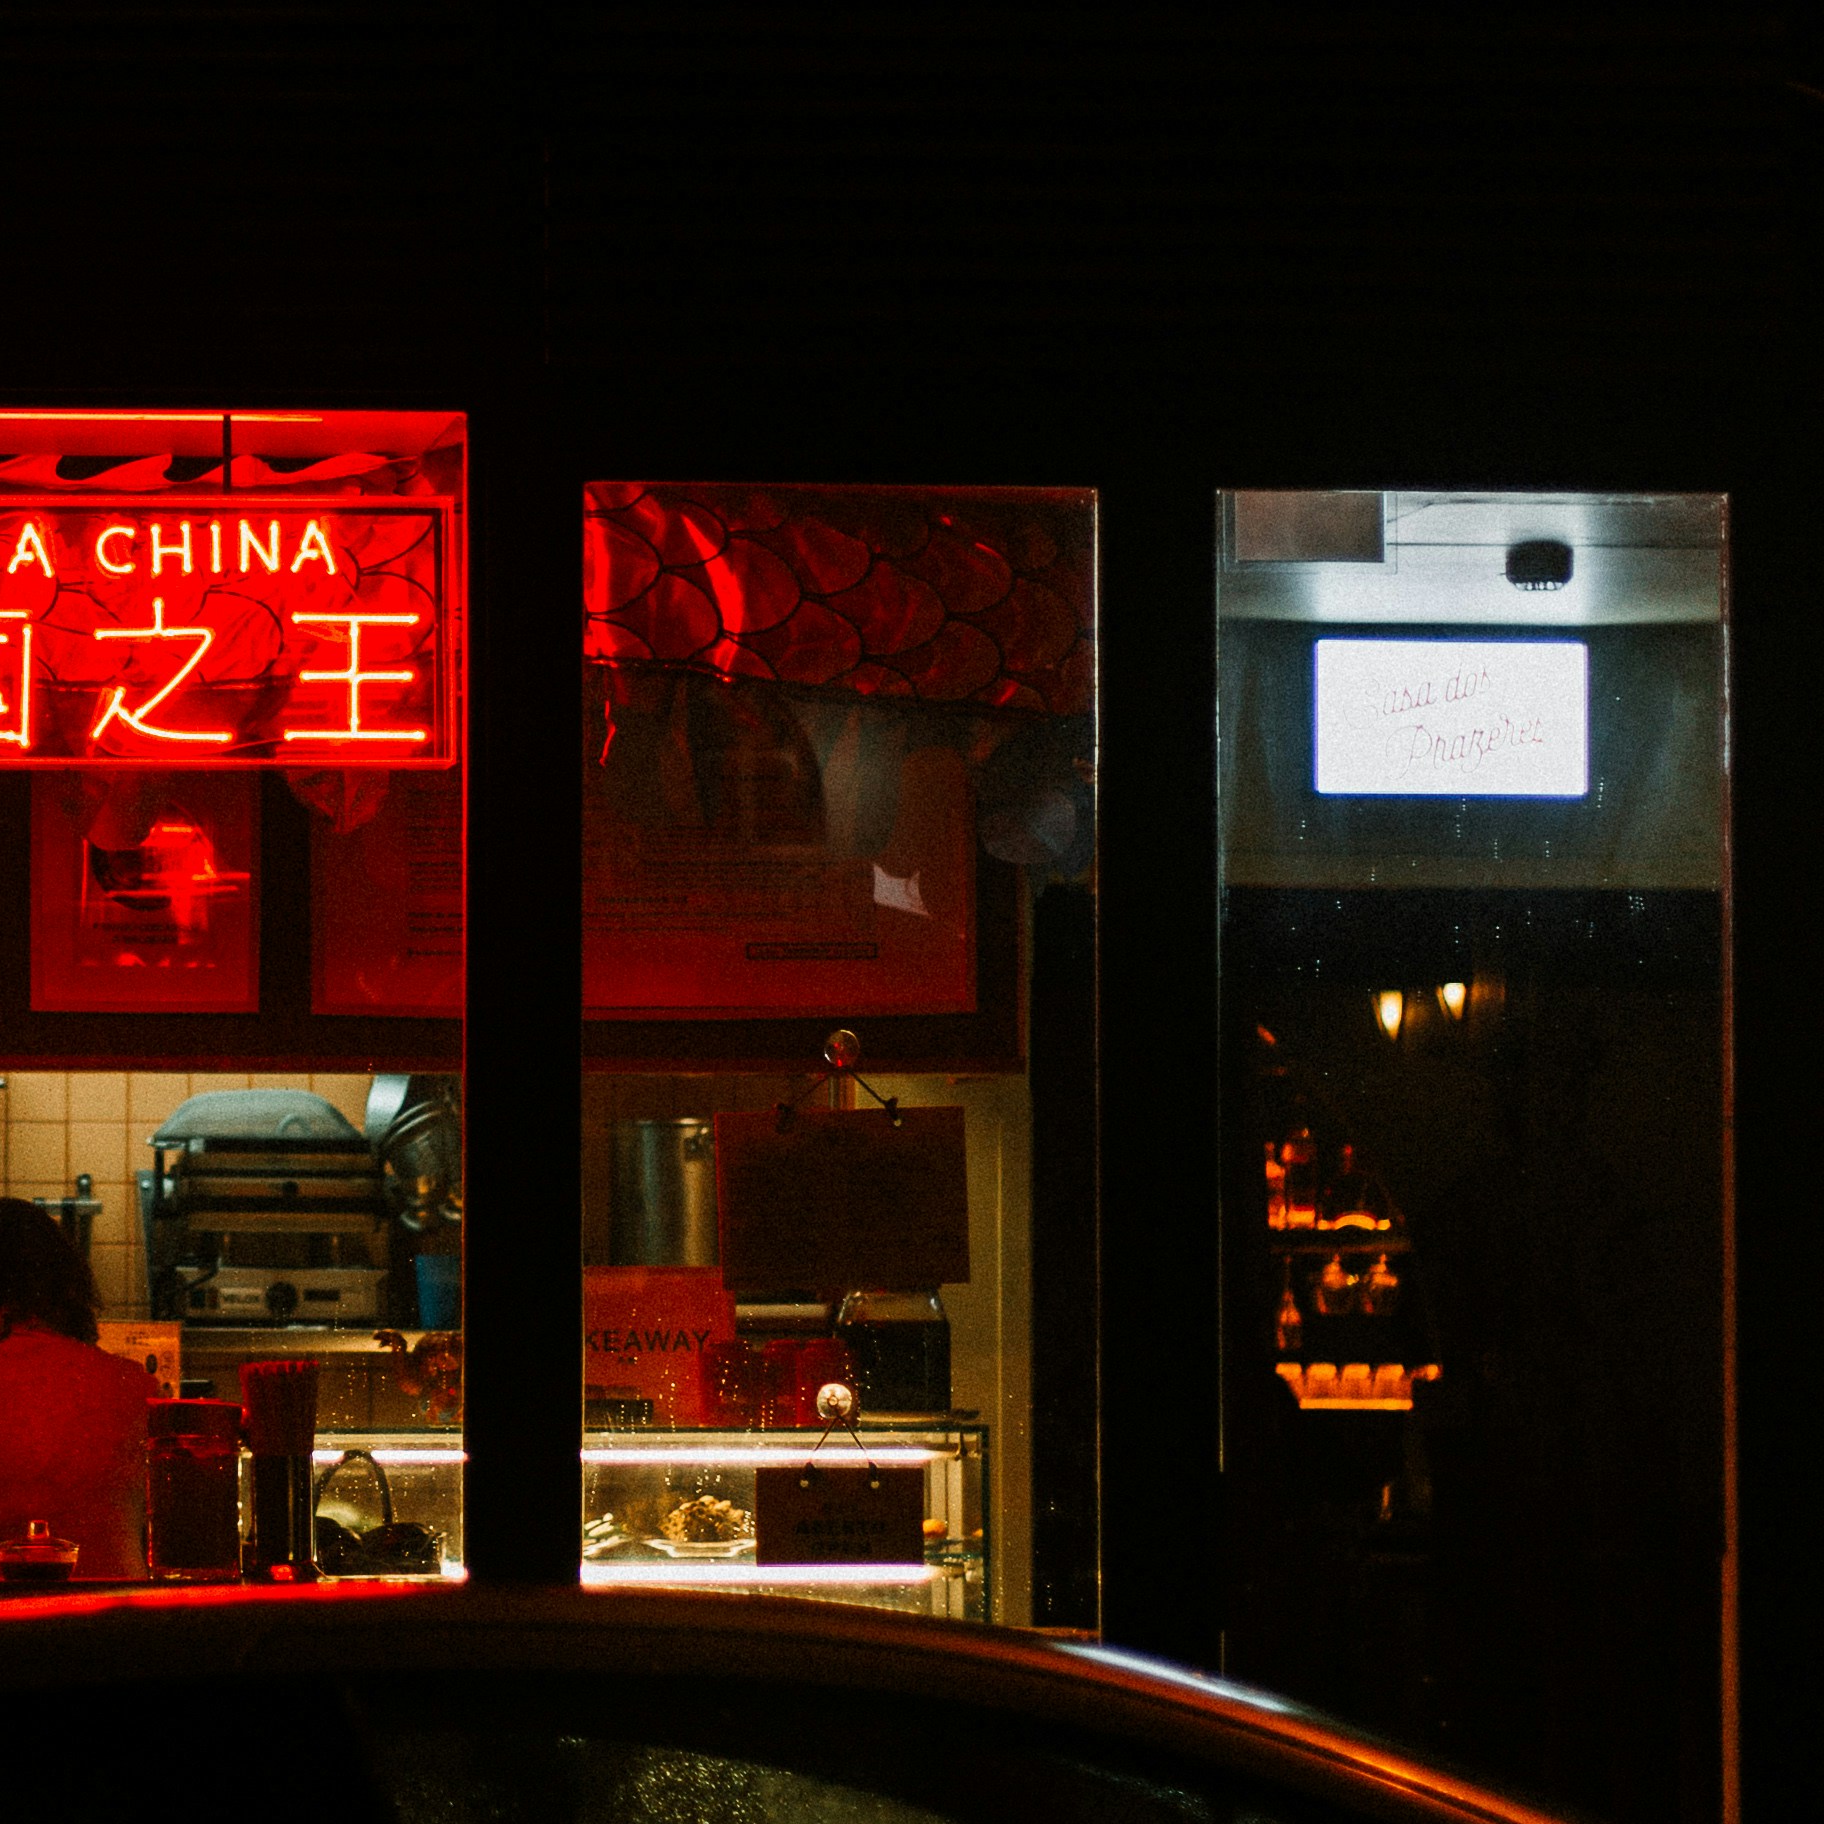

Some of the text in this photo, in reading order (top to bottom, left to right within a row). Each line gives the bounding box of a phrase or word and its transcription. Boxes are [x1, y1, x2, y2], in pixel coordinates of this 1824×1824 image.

[94, 520, 338, 578] CHINA
[1444, 662, 1492, 704] dos
[1385, 713, 1544, 780] Prazeres
